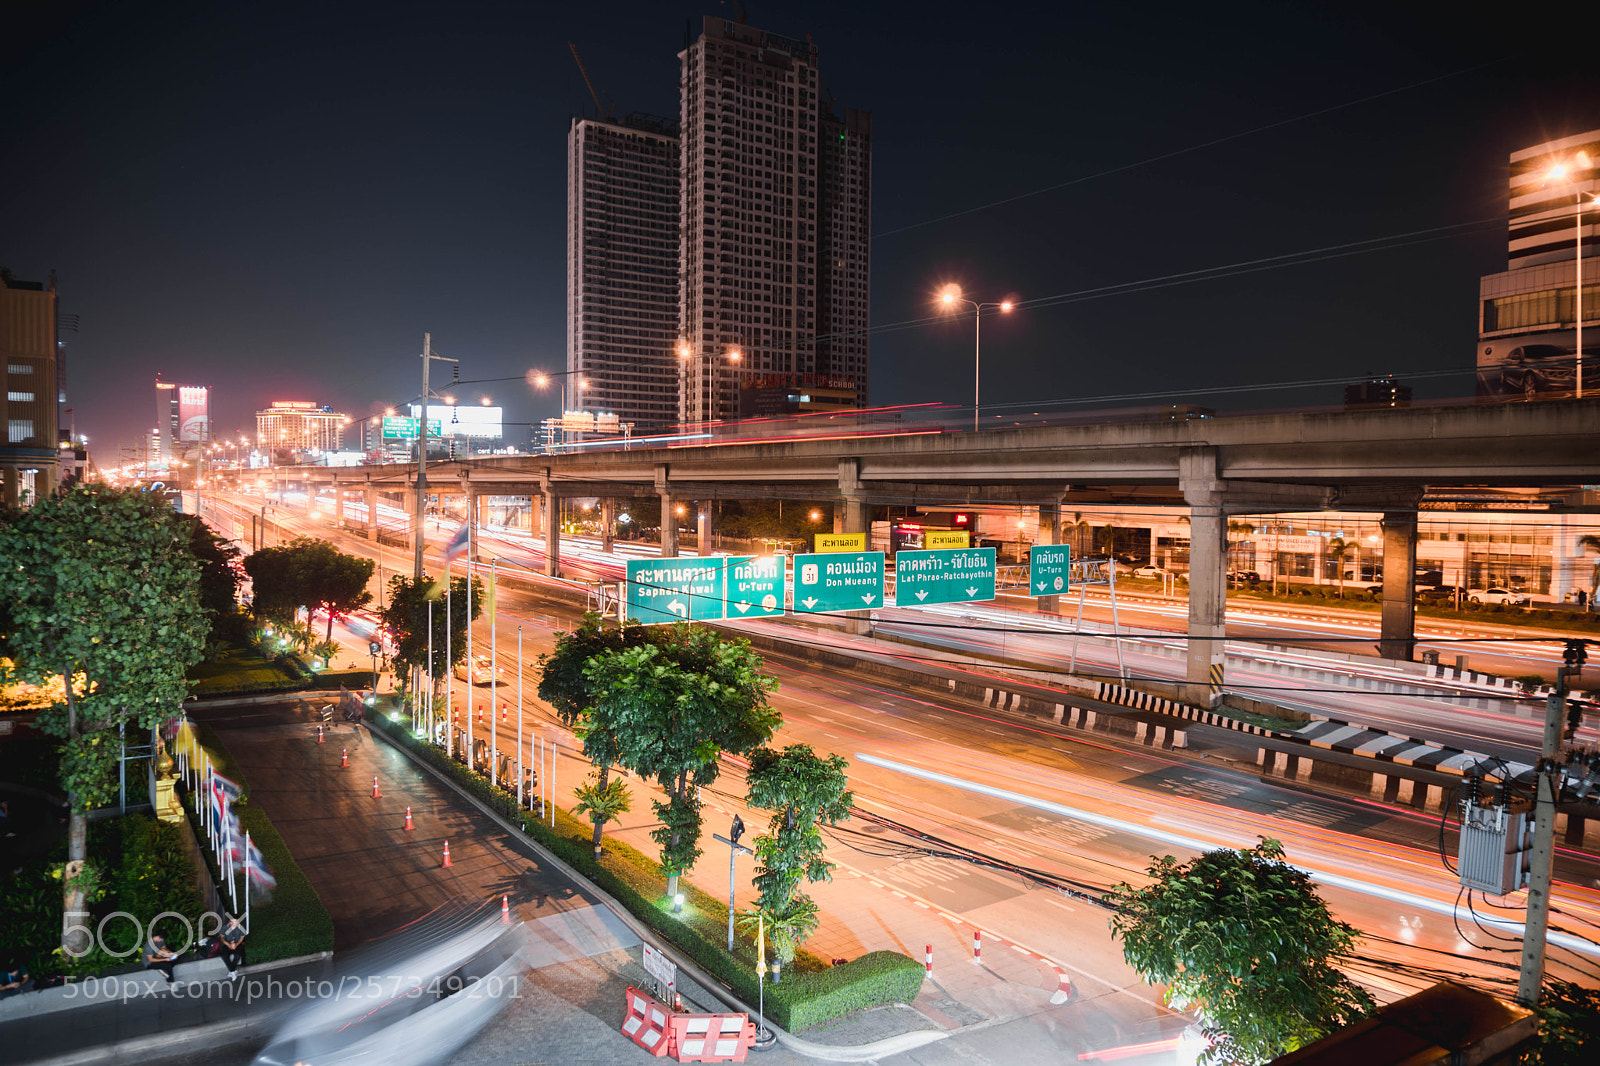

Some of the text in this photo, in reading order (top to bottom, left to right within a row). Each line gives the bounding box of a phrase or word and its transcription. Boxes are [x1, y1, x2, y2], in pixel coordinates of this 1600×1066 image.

[828, 380, 856, 390] SCHOOL
[822, 538, 859, 547] สะพานลอย
[932, 536, 964, 544] สะพานลอย
[1036, 550, 1064, 564] กลับรถ
[826, 557, 877, 575] ดอนเมือง
[1038, 566, 1062, 574] U-Turn
[636, 566, 716, 583] สะพานควาย
[806, 573, 815, 582] 31
[901, 574, 915, 583] Lat
[739, 581, 774, 592] U-Turn
[826, 577, 877, 587] Don Mueang
[638, 583, 714, 598] Saphan Khwai
